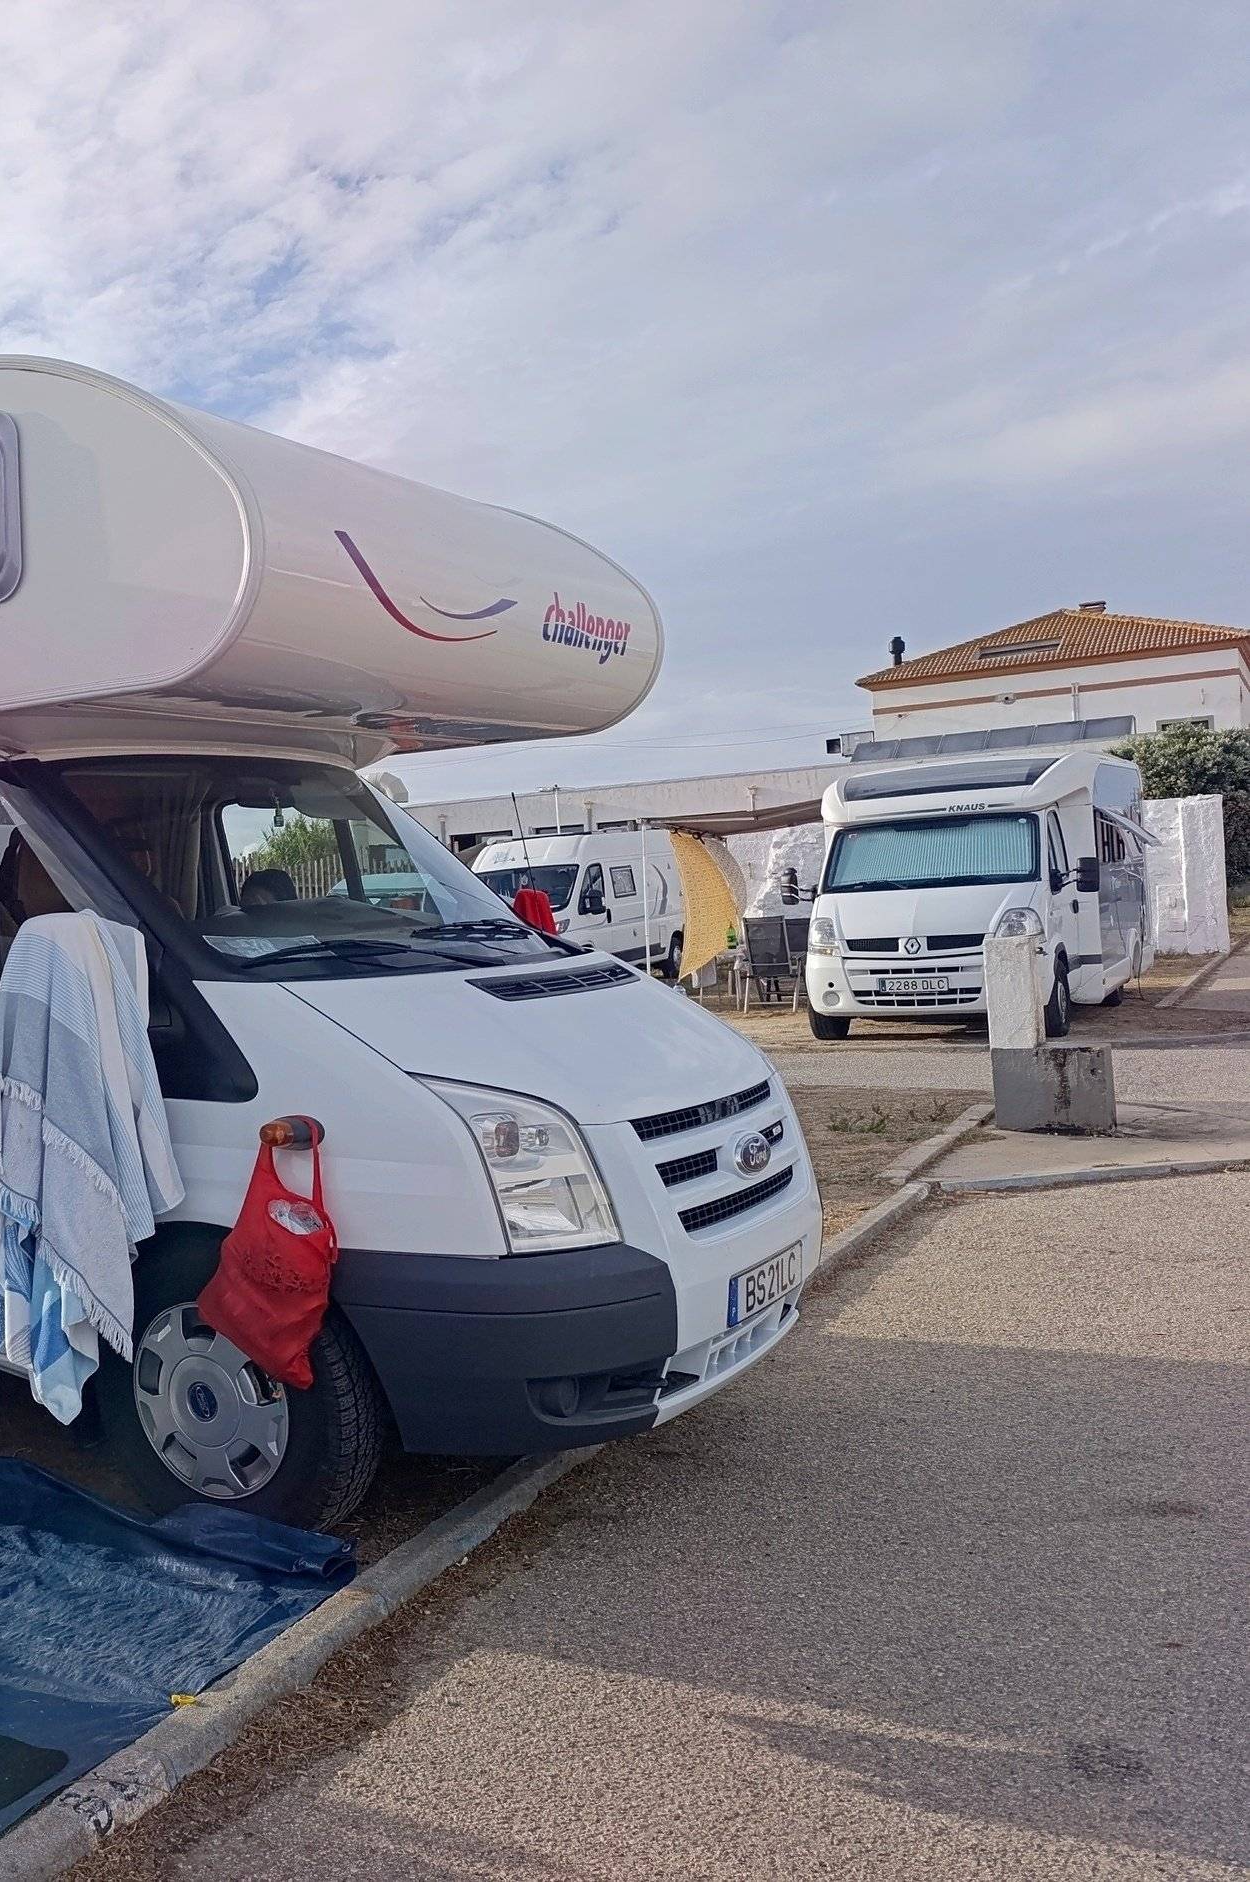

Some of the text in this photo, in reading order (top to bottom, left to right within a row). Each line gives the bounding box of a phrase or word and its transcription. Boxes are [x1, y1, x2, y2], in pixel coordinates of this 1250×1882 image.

[542, 591, 631, 665] challenger
[948, 802, 986, 813] KNAUS
[888, 979, 945, 991] 2288 DLC
[748, 1138, 767, 1166] Ford
